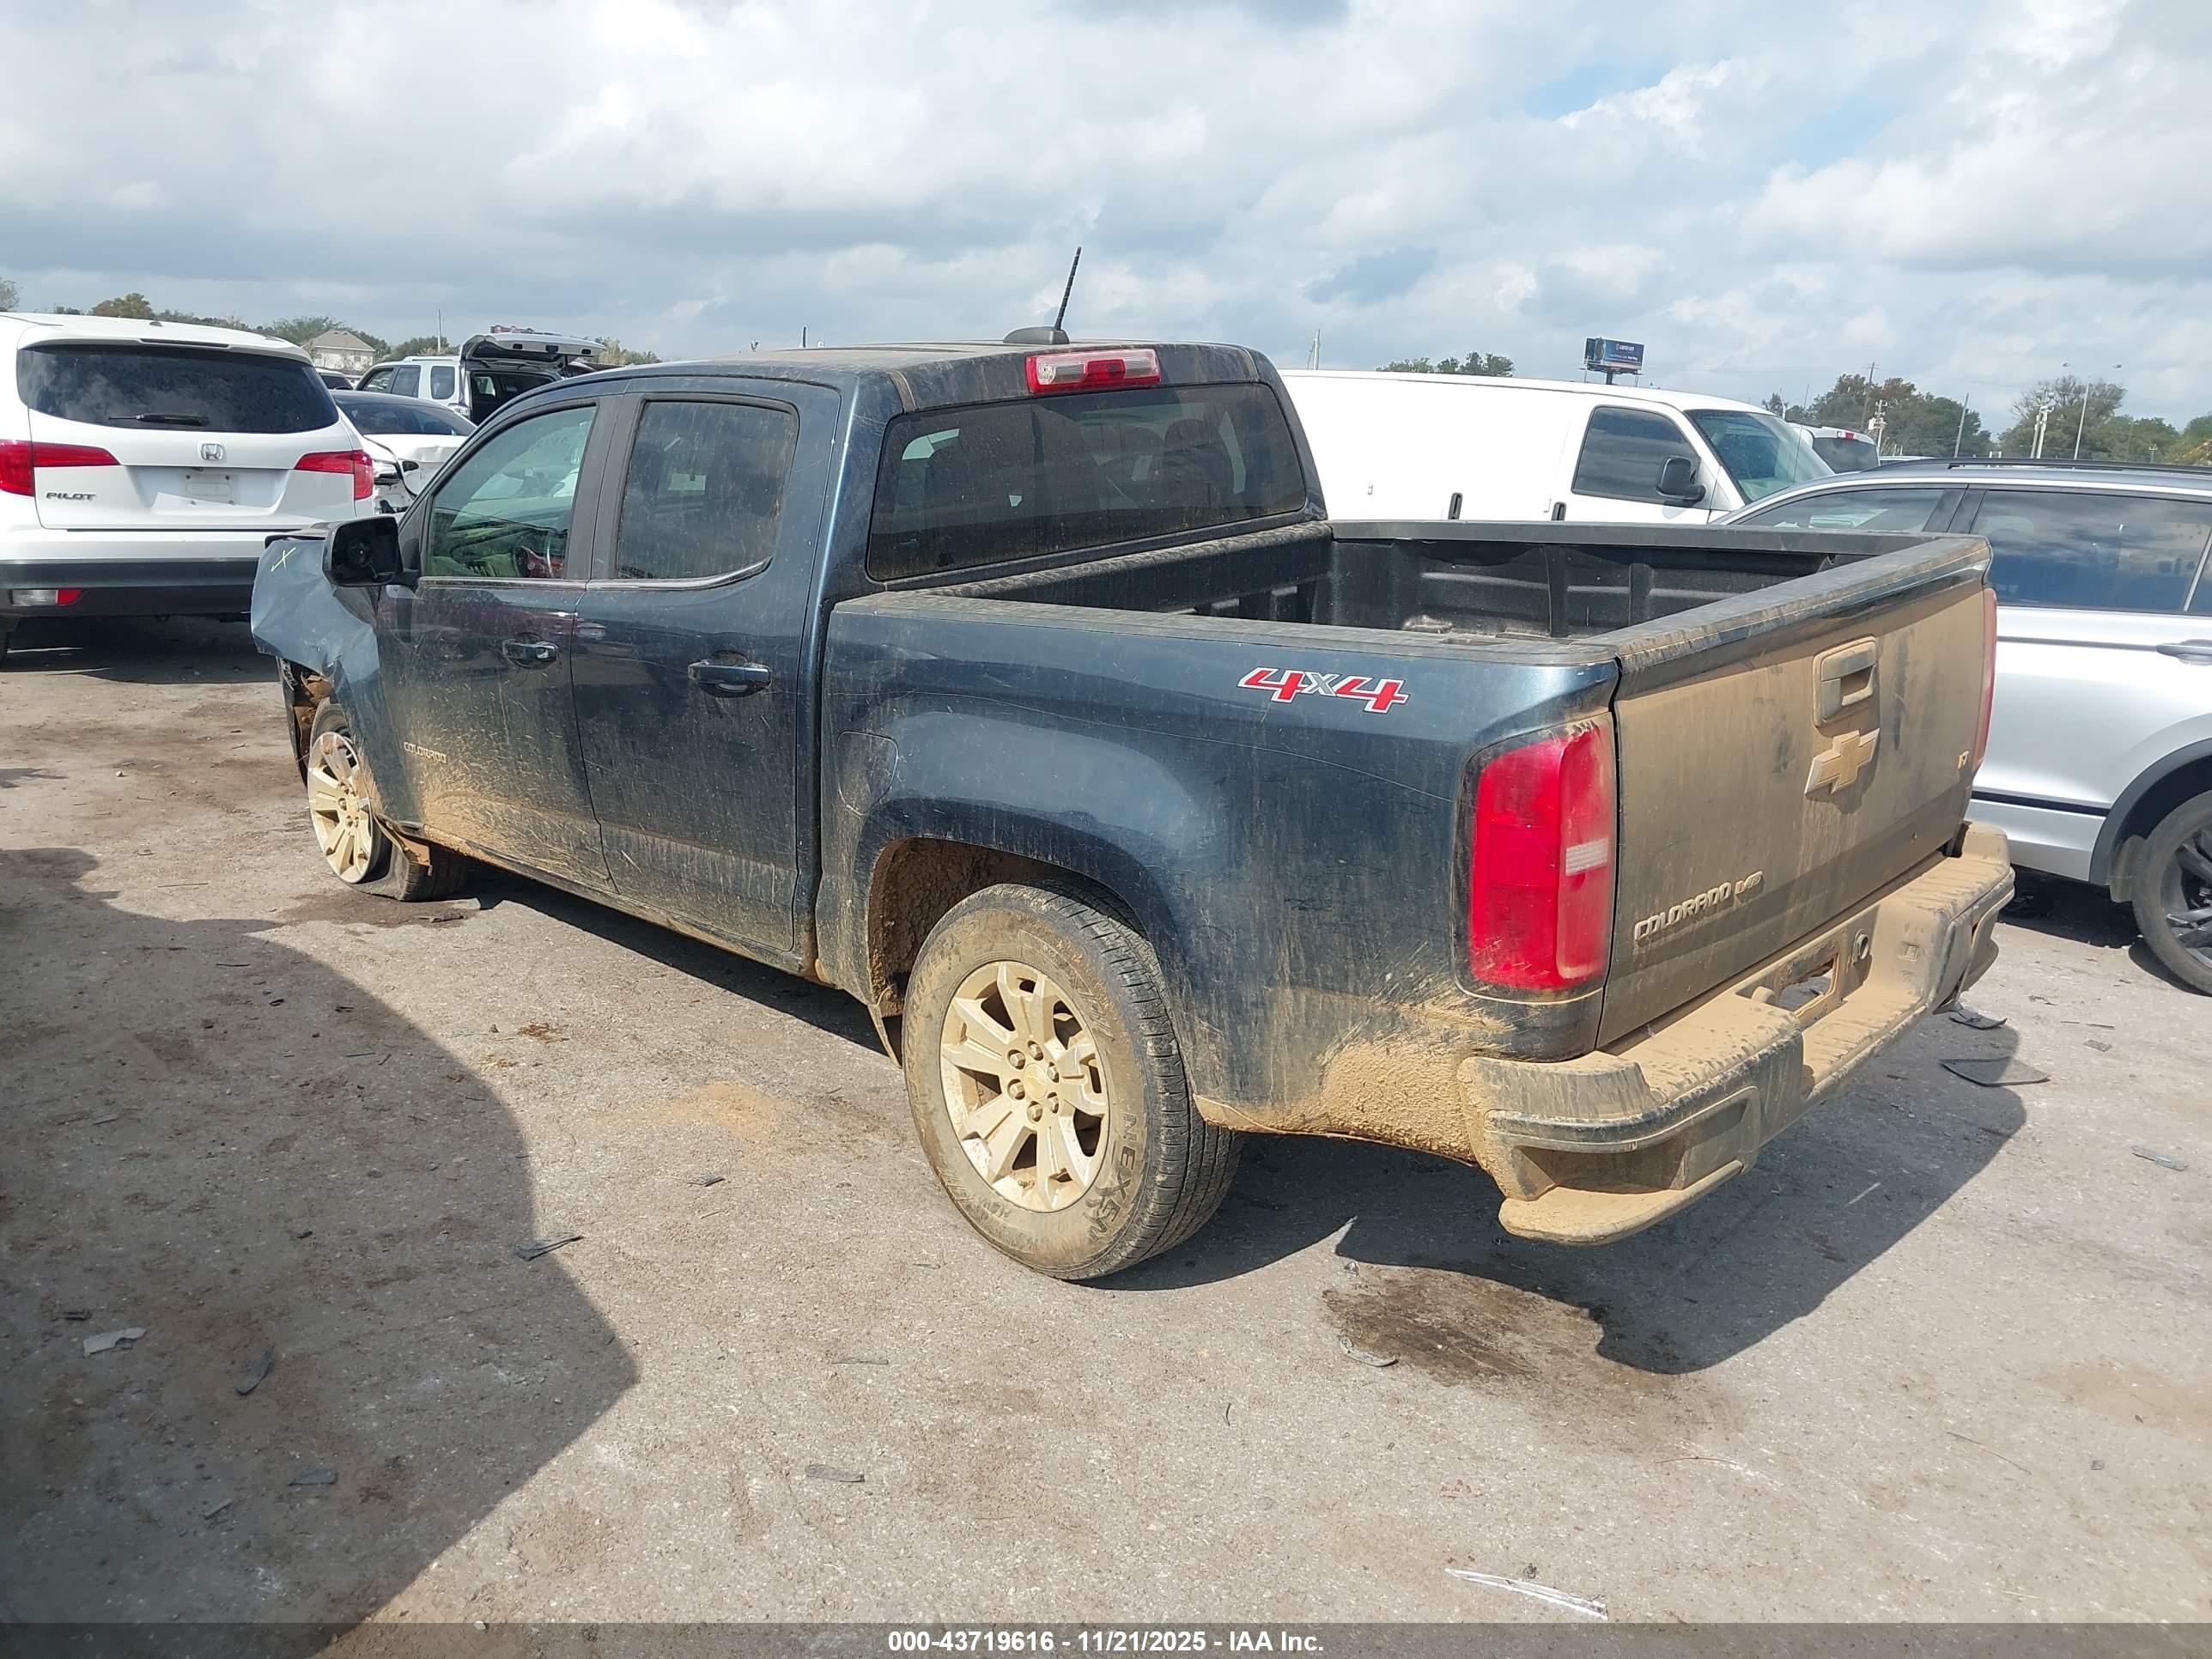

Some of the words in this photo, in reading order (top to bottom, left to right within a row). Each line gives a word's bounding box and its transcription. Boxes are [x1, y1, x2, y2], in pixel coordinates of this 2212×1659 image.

[46, 491, 97, 501] PILOT
[403, 741, 448, 764] COLORADO
[1634, 882, 1732, 941] COLORADO
[1086, 1111, 1137, 1243] NEXEN
